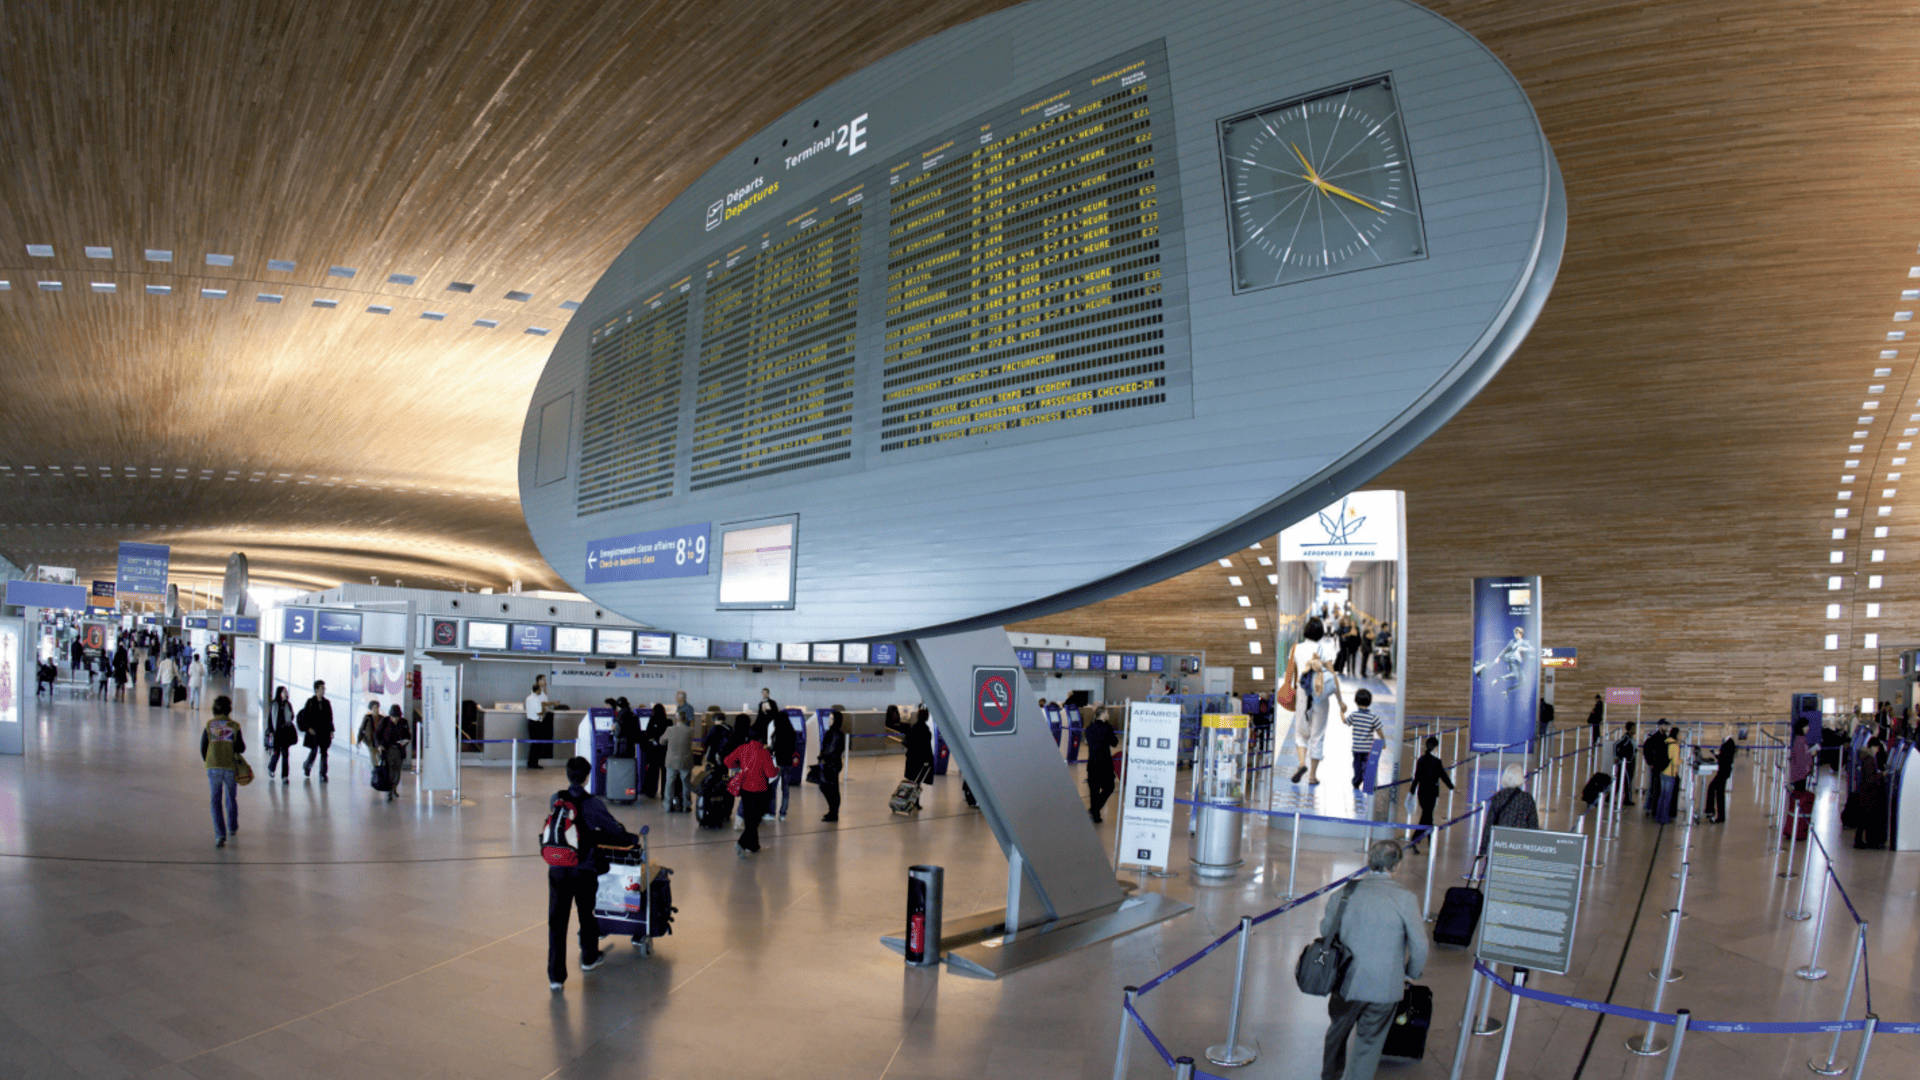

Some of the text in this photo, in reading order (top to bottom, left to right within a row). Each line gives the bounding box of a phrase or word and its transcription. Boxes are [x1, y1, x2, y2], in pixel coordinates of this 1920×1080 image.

[785, 112, 869, 170] Terminal 2E
[725, 181, 779, 220] Departures
[726, 176, 764, 206] Départs
[970, 394, 993, 408] CLASS
[1035, 378, 1071, 394] ECONOMY
[1040, 389, 1092, 408] PASSENGERS
[1097, 377, 1154, 398] CHECKED-IN
[1066, 405, 1093, 419] CLASS
[620, 556, 642, 566] business
[637, 543, 653, 553] classe
[653, 540, 676, 551] affaires
[675, 538, 686, 565] 8
[695, 535, 706, 564] 9
[224, 619, 231, 629] 4
[293, 616, 305, 633] 3
[562, 669, 604, 677] AIRFRANCE
[1494, 840, 1557, 854] AVIS AUX PASSAGERS
